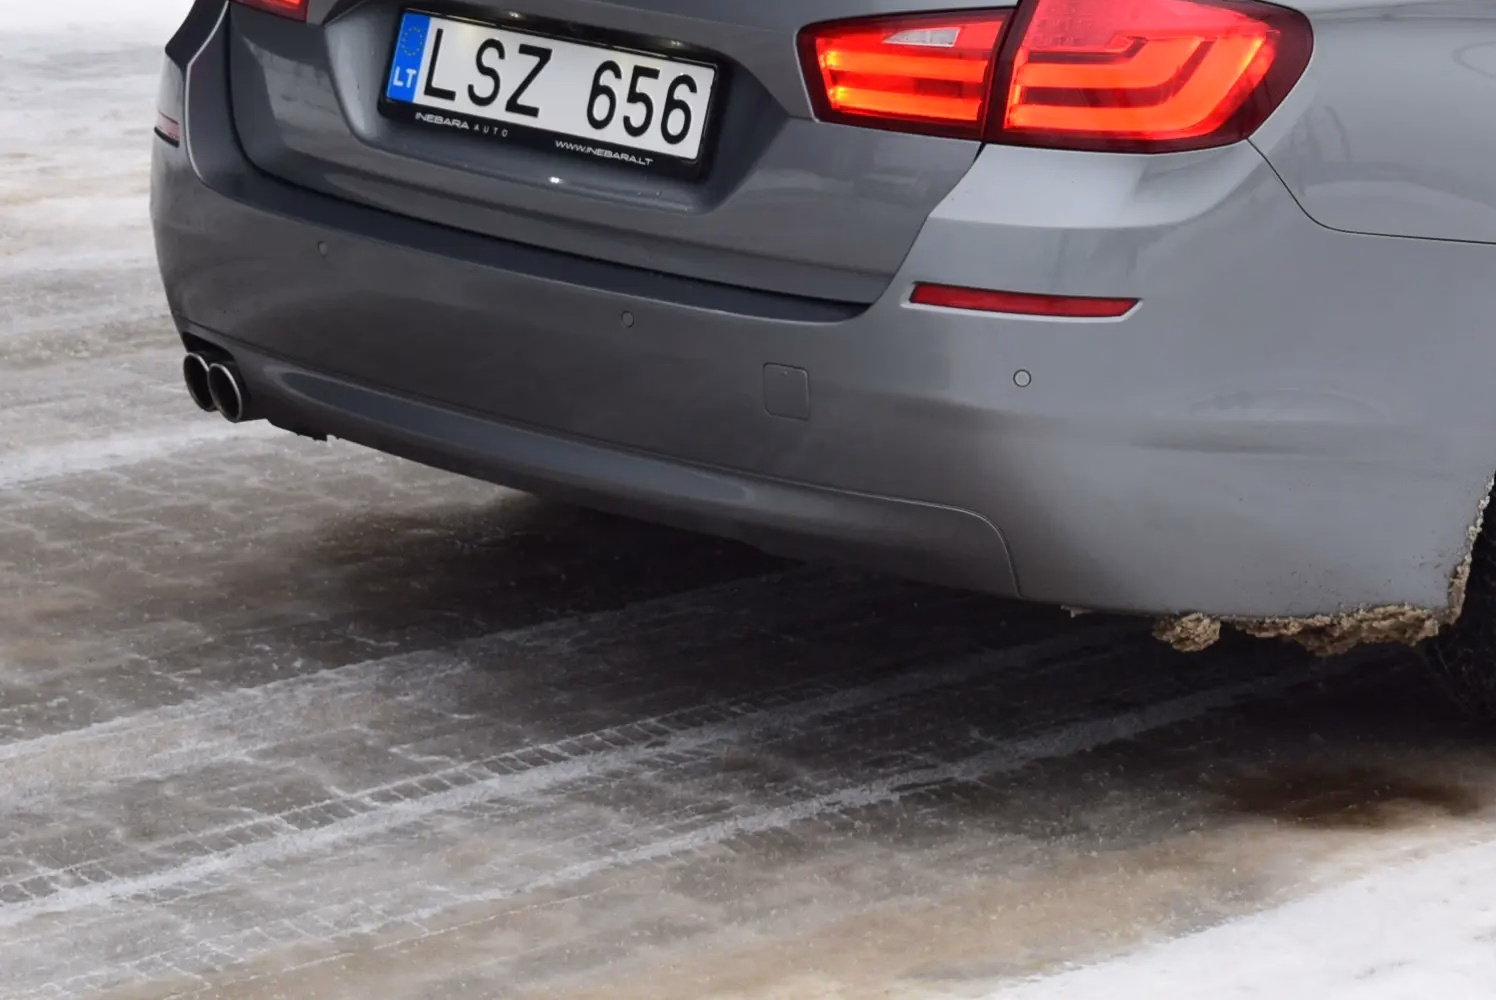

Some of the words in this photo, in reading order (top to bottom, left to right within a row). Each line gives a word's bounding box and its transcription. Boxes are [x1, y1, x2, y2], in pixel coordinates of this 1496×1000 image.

[393, 67, 417, 88] LT
[423, 28, 552, 118] LSZ
[586, 60, 697, 145] 656
[415, 112, 469, 130] INEBARA
[473, 123, 508, 138] AUTO
[555, 140, 653, 165] WWW.INEBARA.LT
